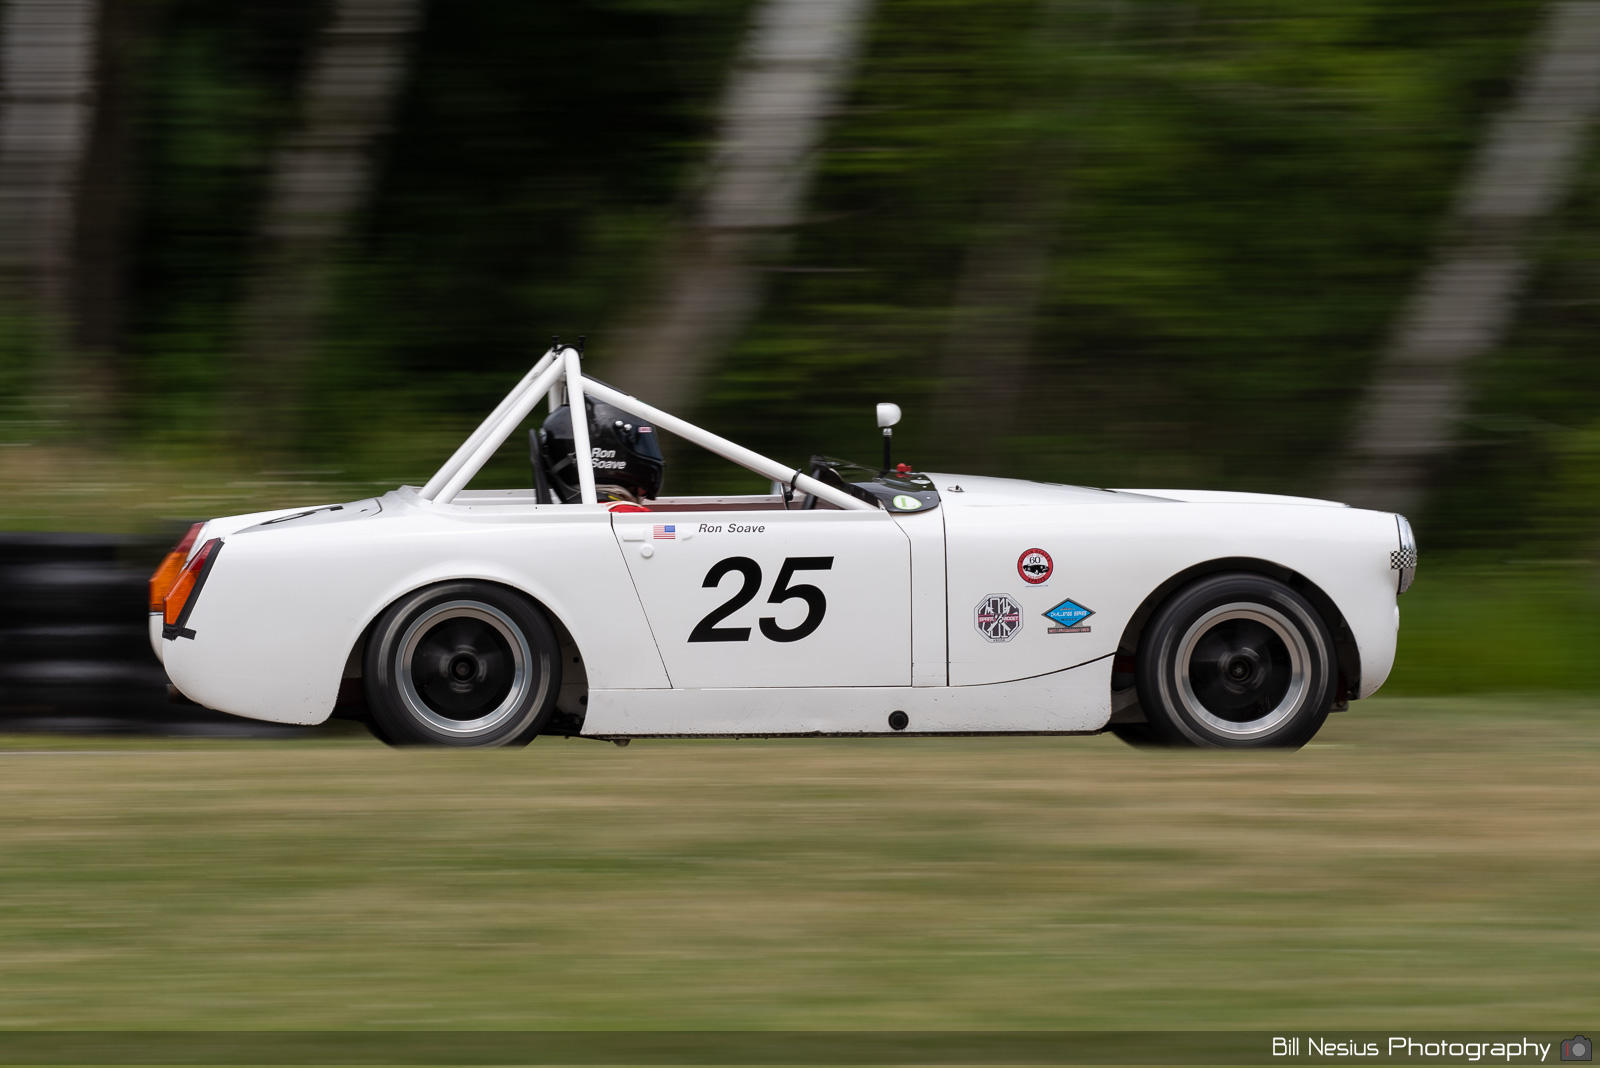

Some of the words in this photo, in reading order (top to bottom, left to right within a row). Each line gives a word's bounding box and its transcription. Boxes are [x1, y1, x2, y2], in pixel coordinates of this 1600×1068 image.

[591, 447, 616, 458] Ron
[698, 523, 722, 533] Ron
[727, 523, 765, 533] Soave
[1029, 556, 1041, 565] 60
[687, 556, 835, 643] 25
